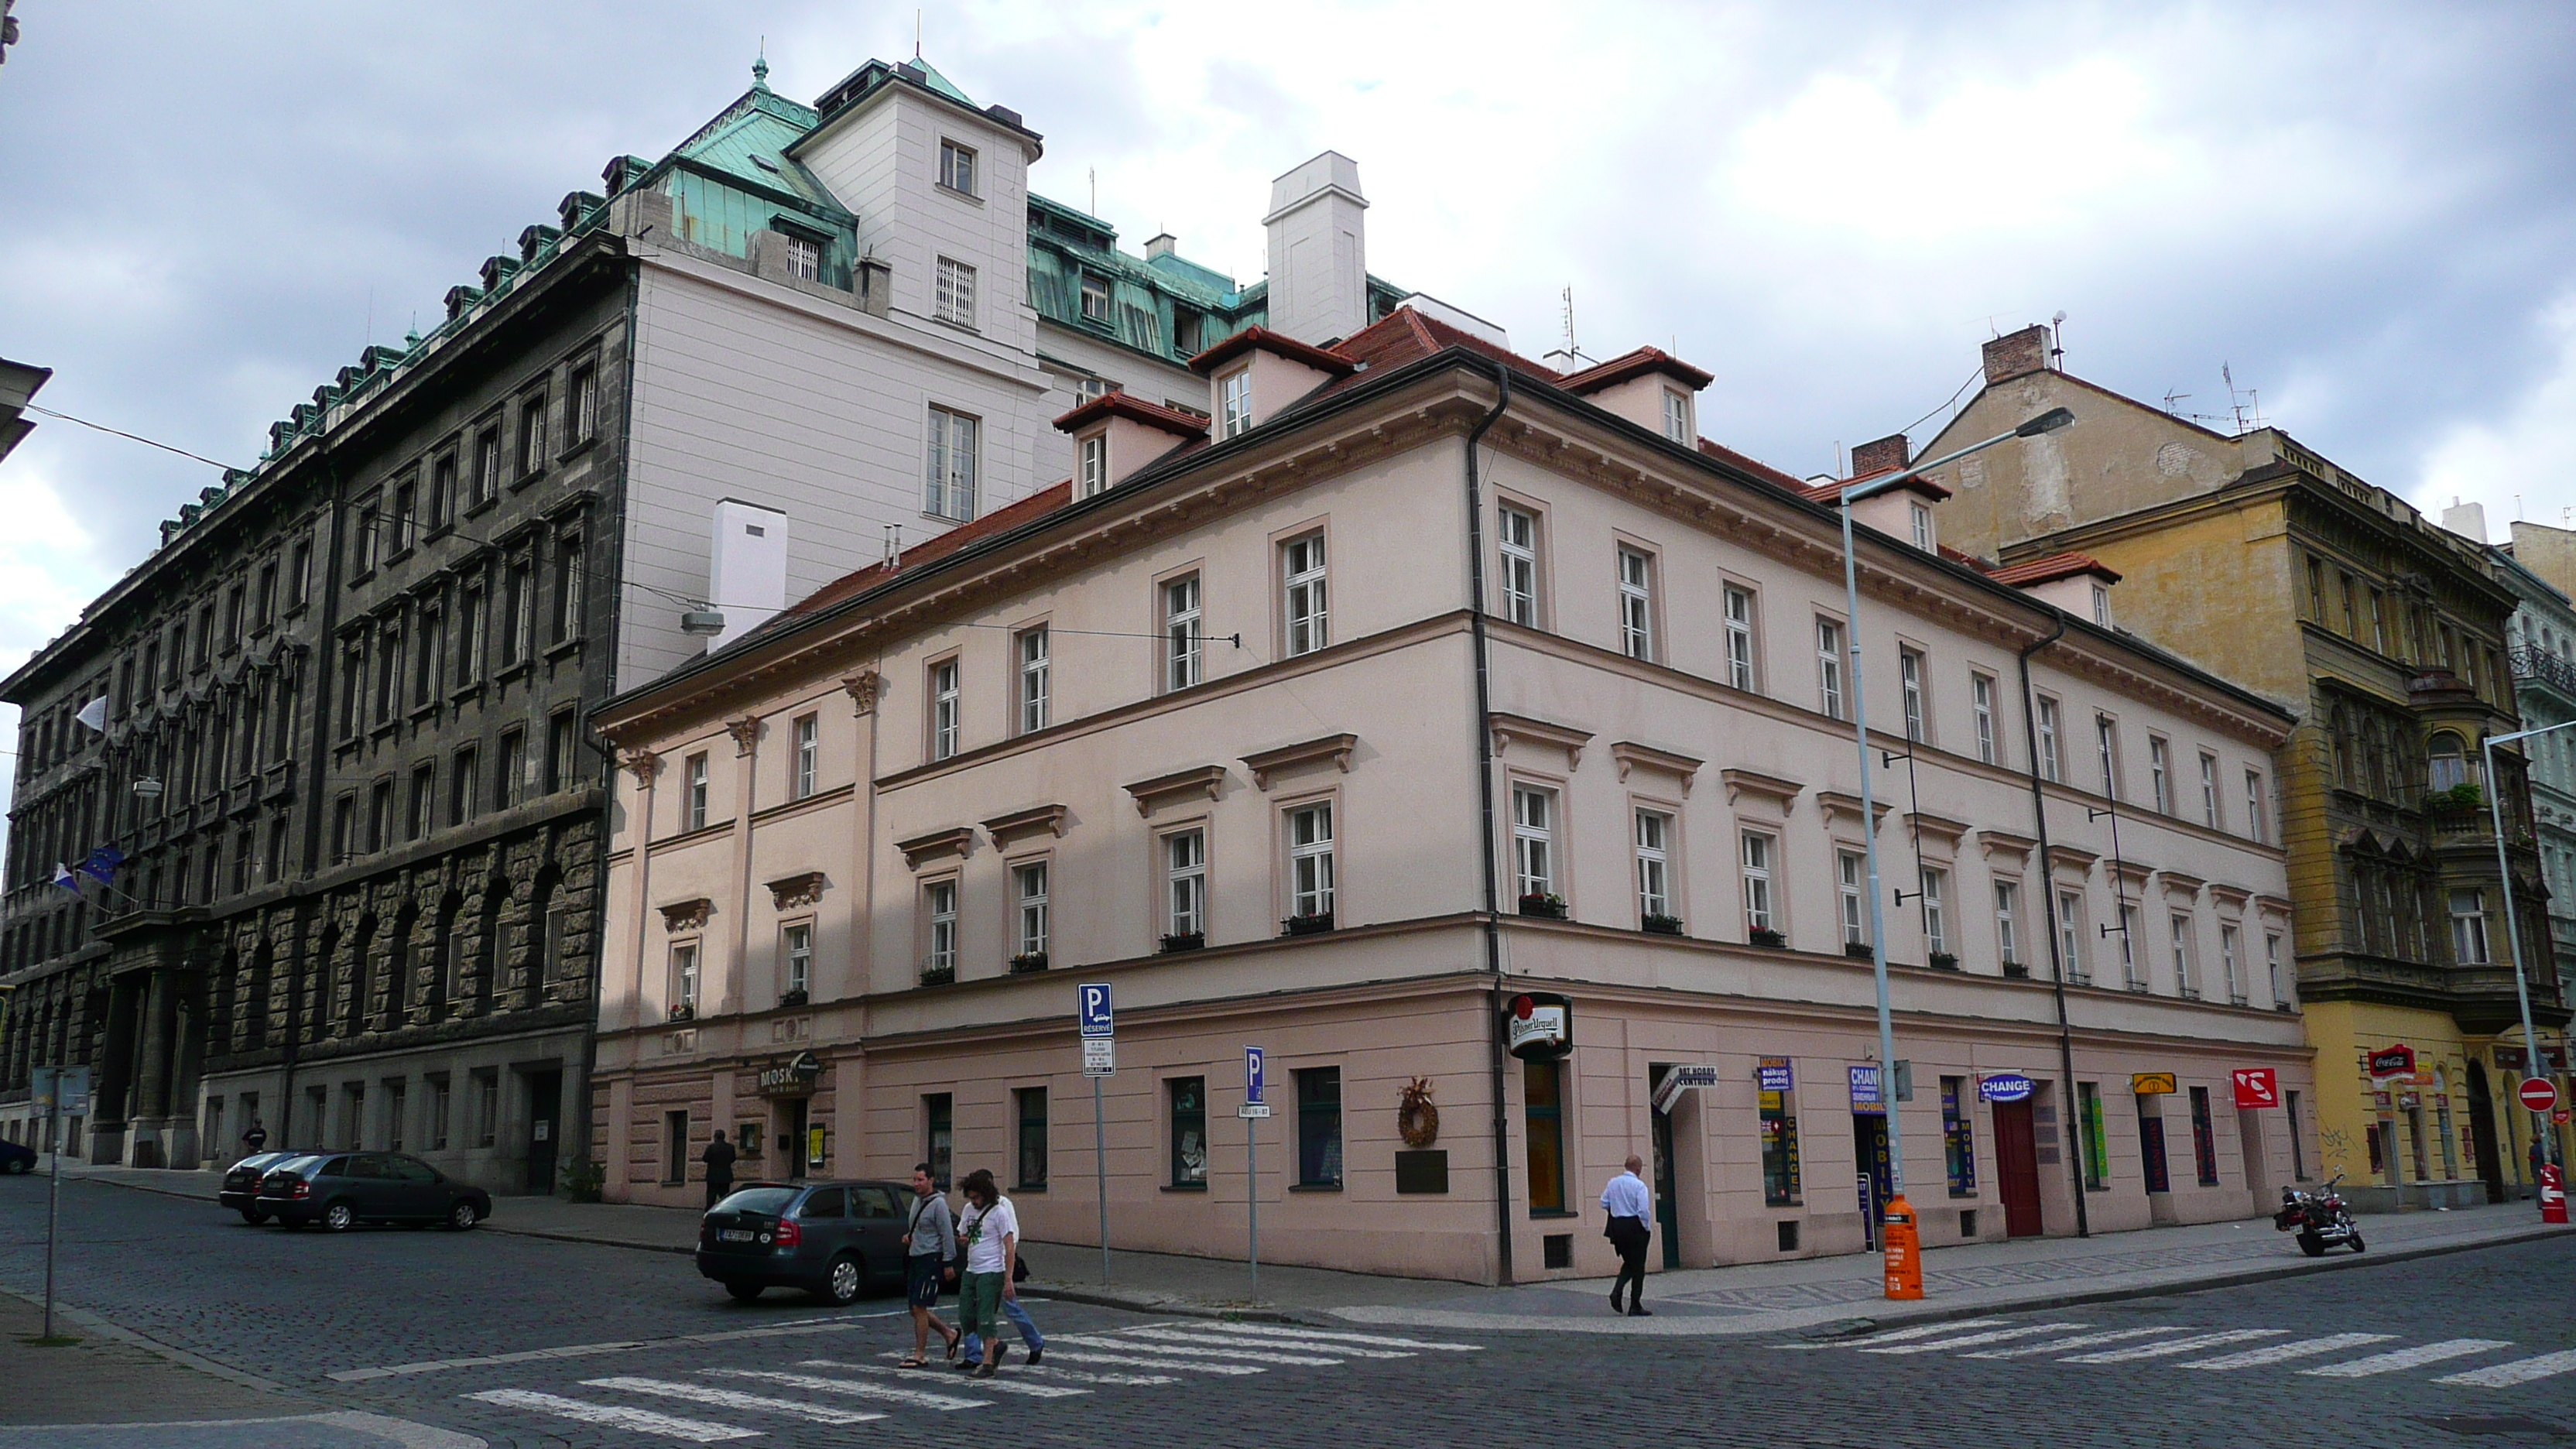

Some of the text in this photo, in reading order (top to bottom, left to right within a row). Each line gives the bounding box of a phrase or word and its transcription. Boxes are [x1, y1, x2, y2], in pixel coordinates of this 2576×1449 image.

[1088, 988, 1102, 1017] P
[1084, 1023, 1112, 1033] RÉSERVÉ
[1513, 1017, 1557, 1040] Pilsner Urquell
[1249, 1053, 1260, 1086] P
[1761, 1057, 1787, 1067] MOBILY
[2376, 1057, 2405, 1067] Coca-Cola
[761, 1068, 798, 1088] MOSK
[1763, 1077, 1789, 1085] prodej
[1851, 1069, 1878, 1084] CHAN
[1982, 1081, 2030, 1092] CHANGE
[1786, 1118, 1799, 1184] CHANGE
[1961, 1122, 1974, 1186] MOBILY
[1873, 1119, 1890, 1209] MOBILY
